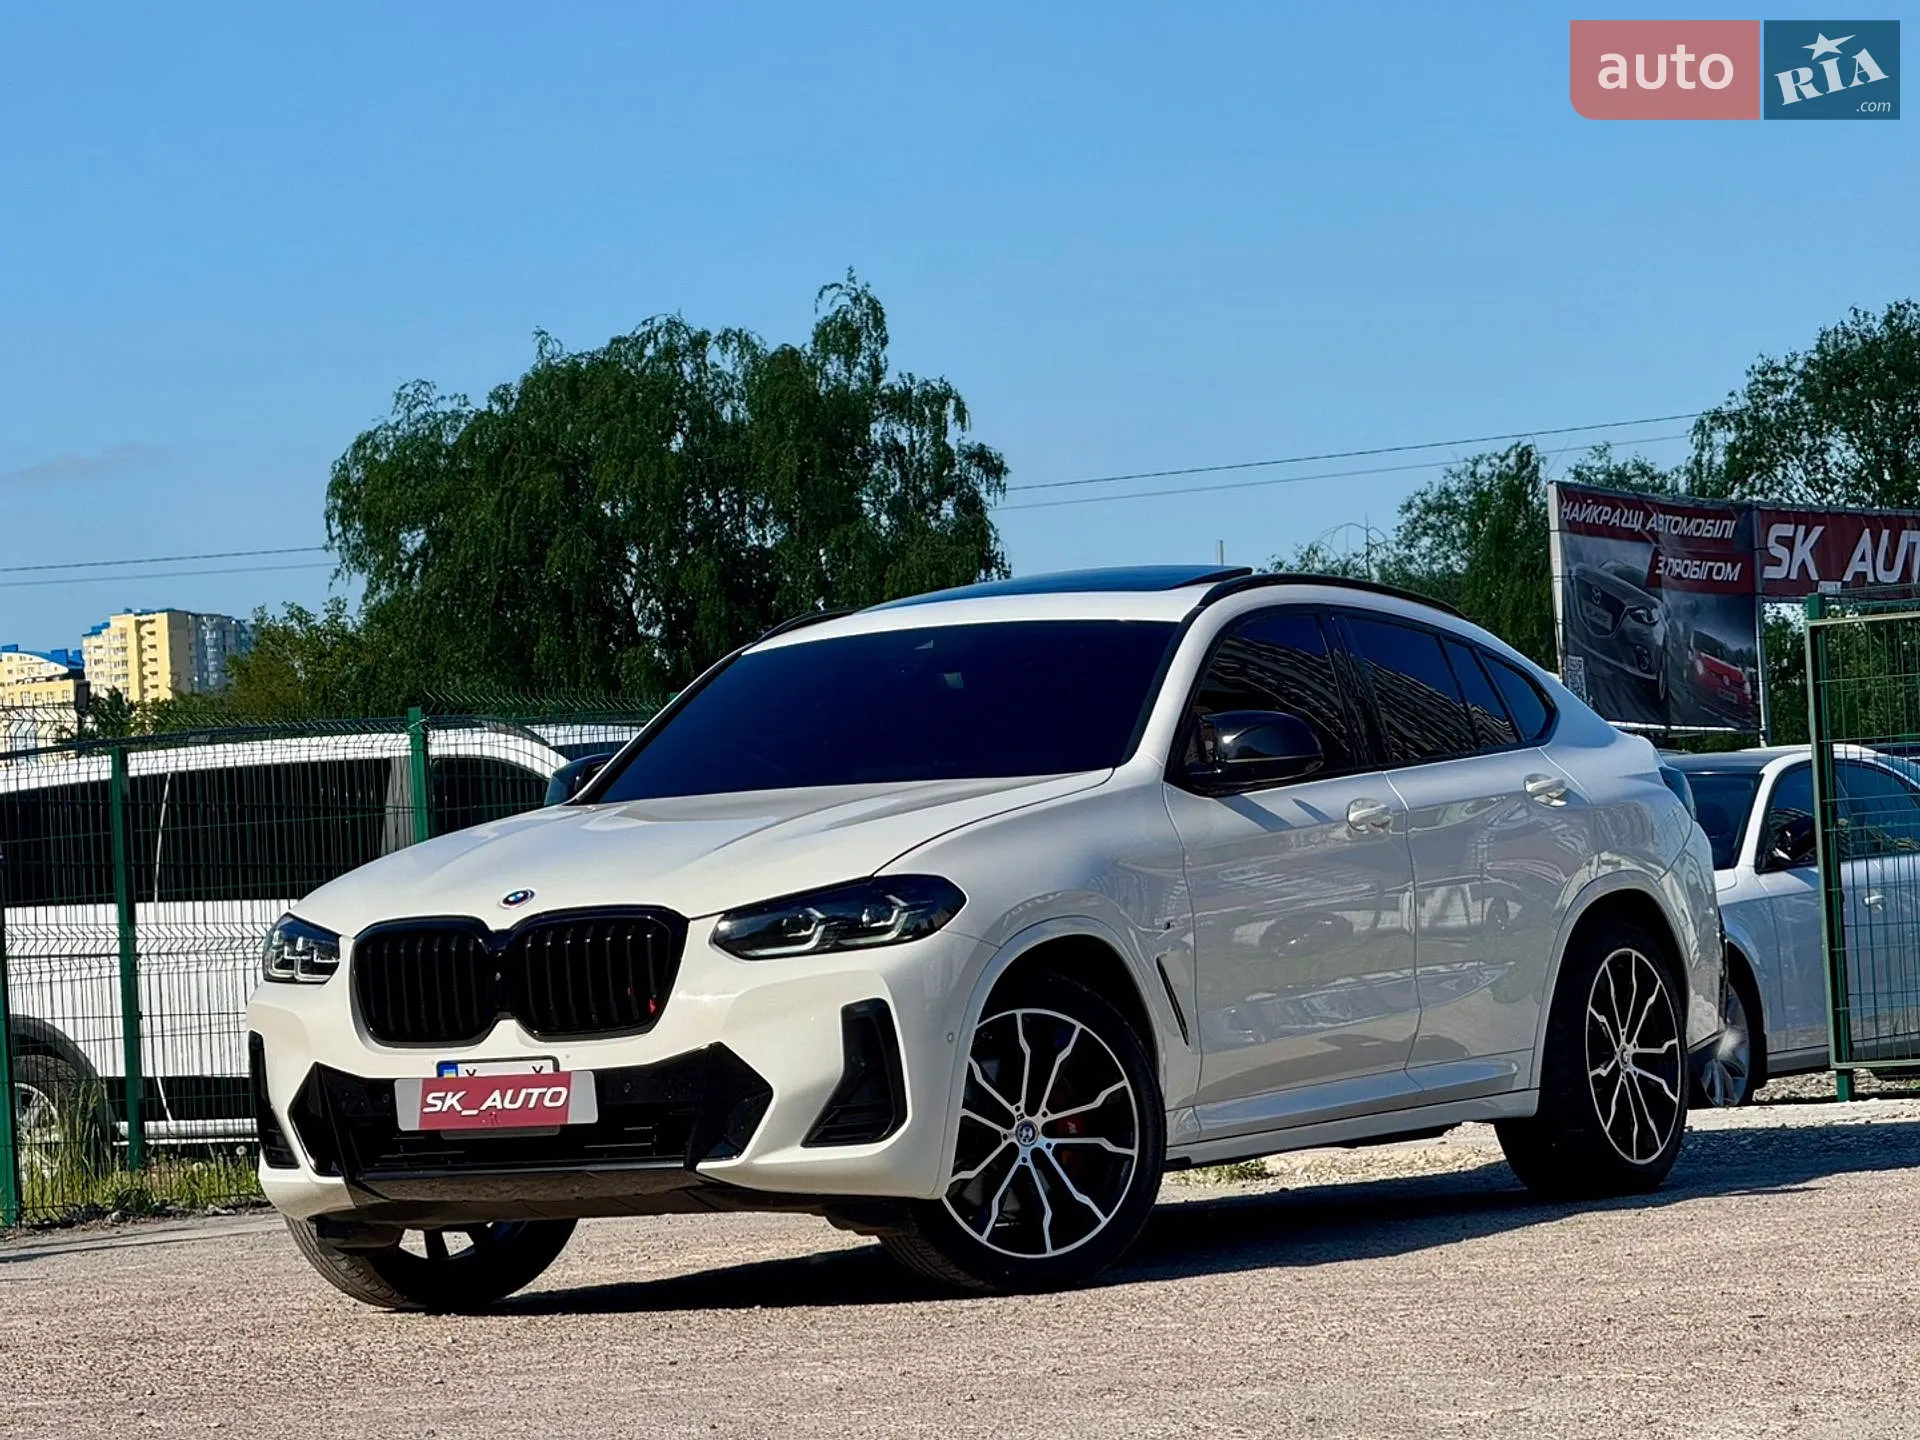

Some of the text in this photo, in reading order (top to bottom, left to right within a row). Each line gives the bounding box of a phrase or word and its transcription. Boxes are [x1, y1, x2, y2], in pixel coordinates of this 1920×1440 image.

[1561, 499, 1736, 538] НАЙКРАЩІ АВТОМОБІЛІ
[1665, 558, 1742, 582] ПРОБІГОМ
[422, 1086, 568, 1116] SK_AUTO
